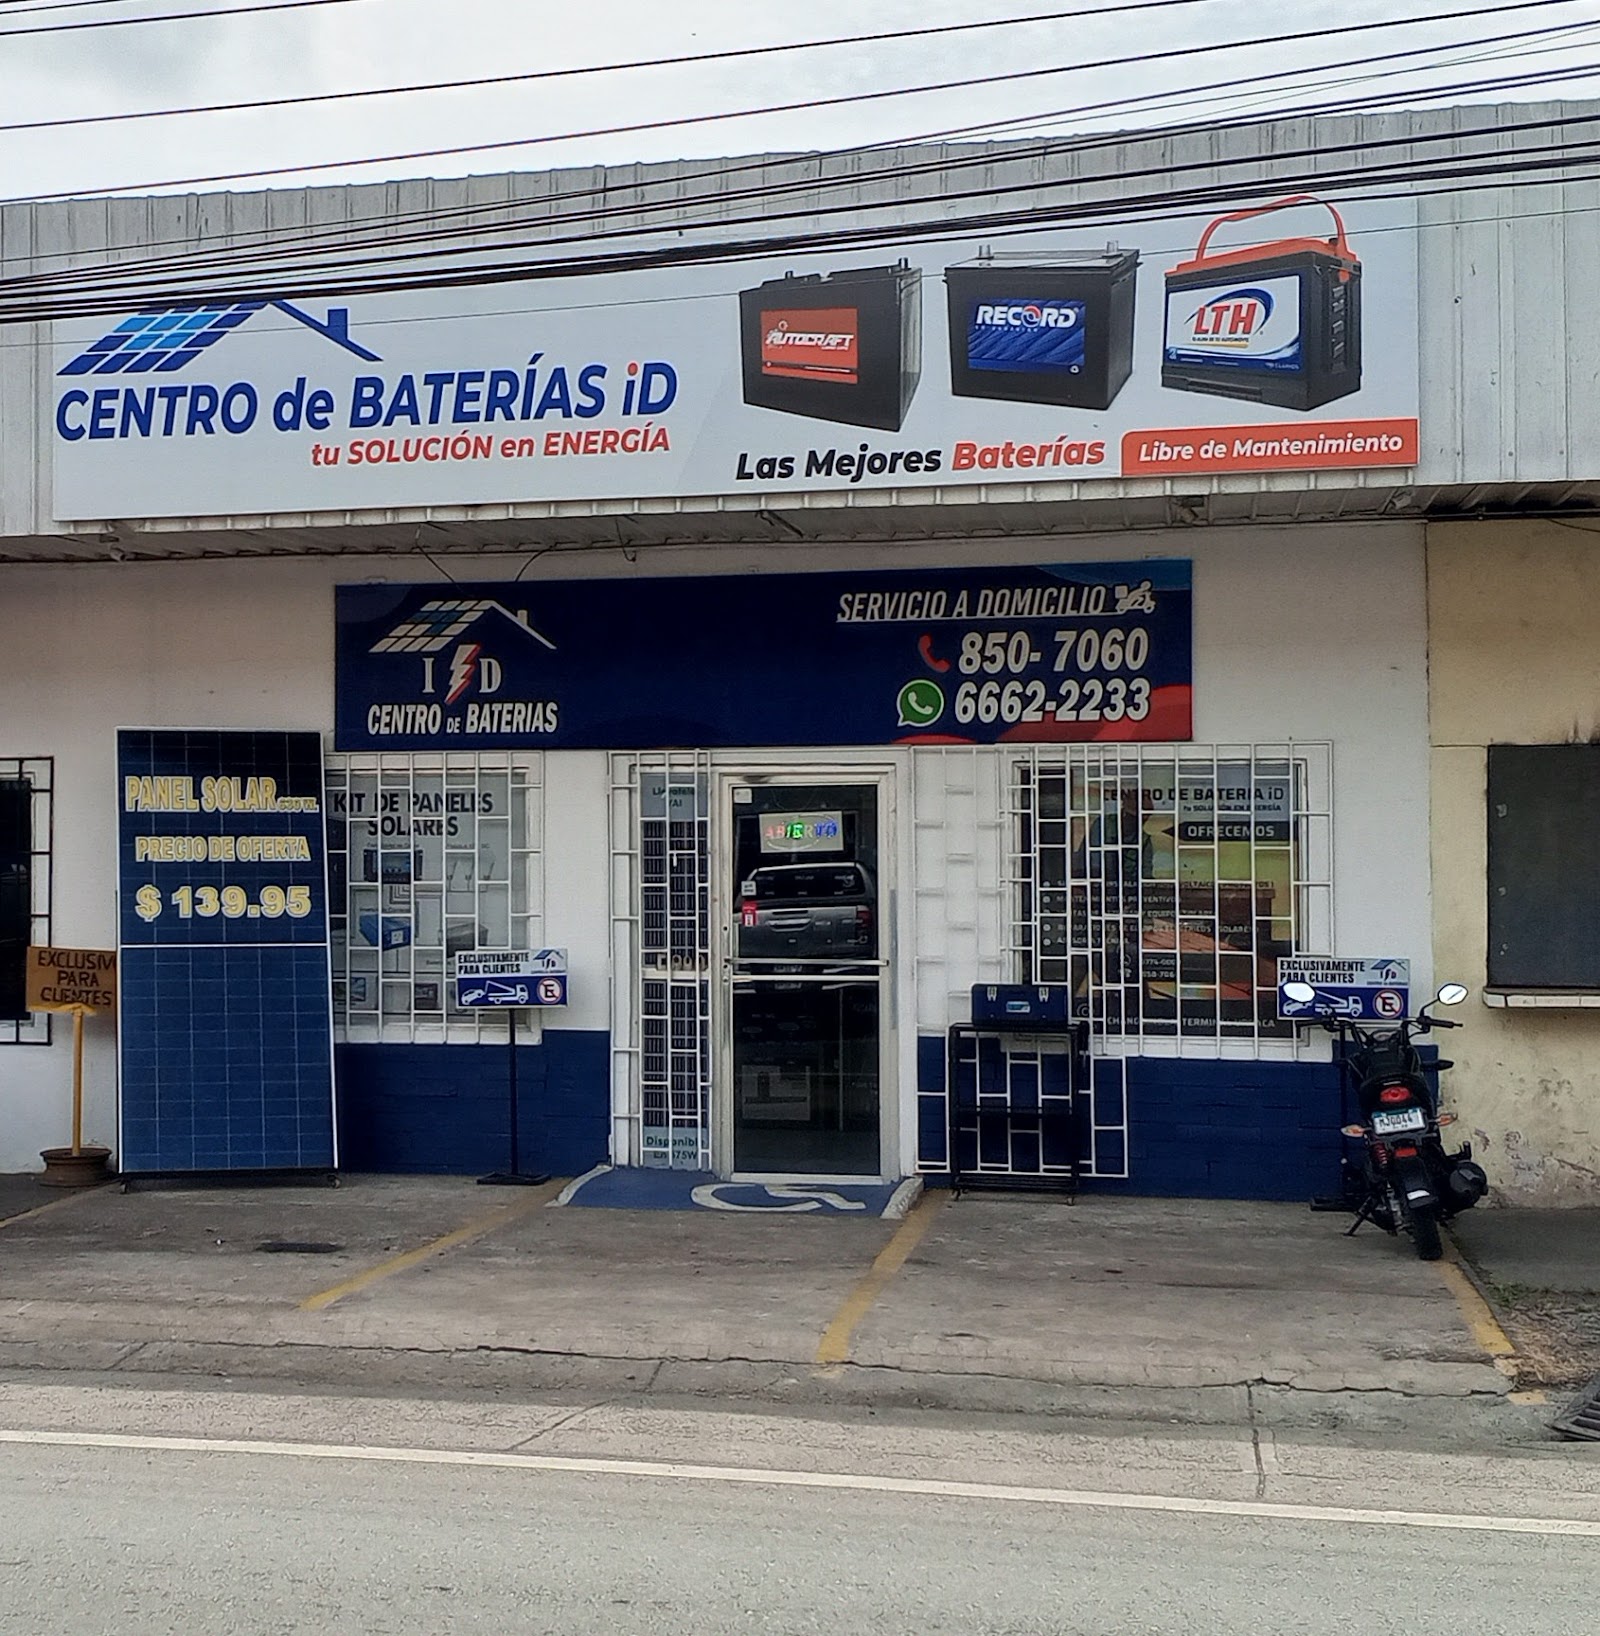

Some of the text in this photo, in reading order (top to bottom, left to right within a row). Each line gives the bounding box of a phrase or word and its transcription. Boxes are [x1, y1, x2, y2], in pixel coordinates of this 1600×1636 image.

[976, 305, 1077, 328] RECORD
[1194, 303, 1258, 334] LTH
[765, 330, 854, 347] AUTOCRAFT
[56, 353, 677, 441] CENTRO de BATERÍAS iD
[311, 422, 670, 466] tu SOLUCIÓN en ENERGÍA
[1139, 432, 1403, 461] Libre de Mantenimiento
[735, 435, 1105, 482] Las Mejores Baterías
[837, 586, 1107, 620] SERVICIO A DOMICILIO
[958, 627, 1149, 674] 850- 7060
[955, 677, 1151, 723] 6662-2233
[367, 702, 558, 735] CENTRO DE BATERIAS
[125, 776, 200, 812] PANEL
[201, 776, 277, 812] SOLAR
[333, 792, 493, 813] KIT DE PANELES
[1168, 788, 1189, 800] DE
[367, 816, 458, 836] SOLARES
[765, 822, 838, 839] ABIERTO
[1188, 825, 1275, 837] OFRECEMOS
[135, 836, 311, 862] PRECIO DE OFERTA
[135, 884, 311, 922] $ 139.95
[38, 950, 116, 970] EXCLUSIV
[458, 952, 530, 963] EXCLUSIVAMENTE
[458, 963, 521, 974] PARA CLIENTES
[1280, 960, 1365, 972] EXCLUSIVAMENTE
[57, 970, 99, 987] PARA
[1280, 972, 1355, 983] PARA CLIENTES
[40, 986, 112, 1006] CLIENTES
